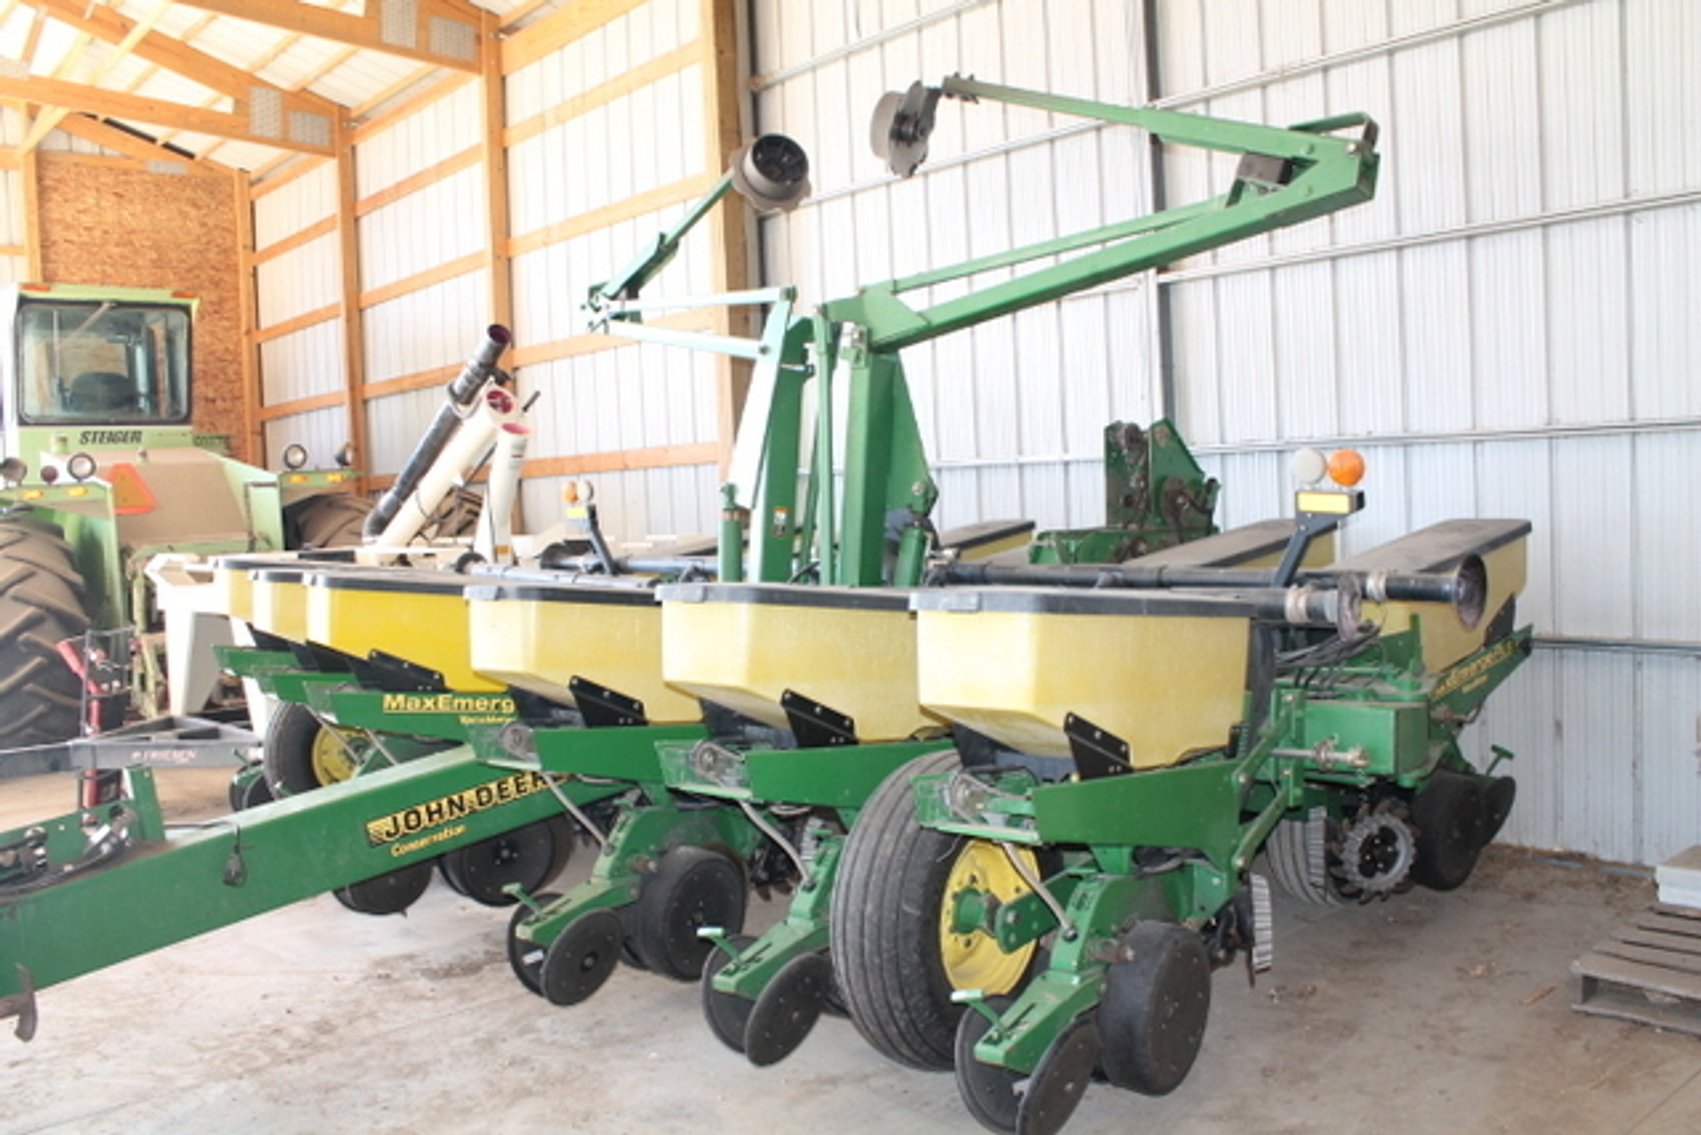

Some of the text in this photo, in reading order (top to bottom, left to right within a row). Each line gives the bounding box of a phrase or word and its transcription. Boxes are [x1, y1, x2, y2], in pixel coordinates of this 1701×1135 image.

[81, 431, 143, 445] STEIGER
[386, 771, 556, 838] JOHN DEER
